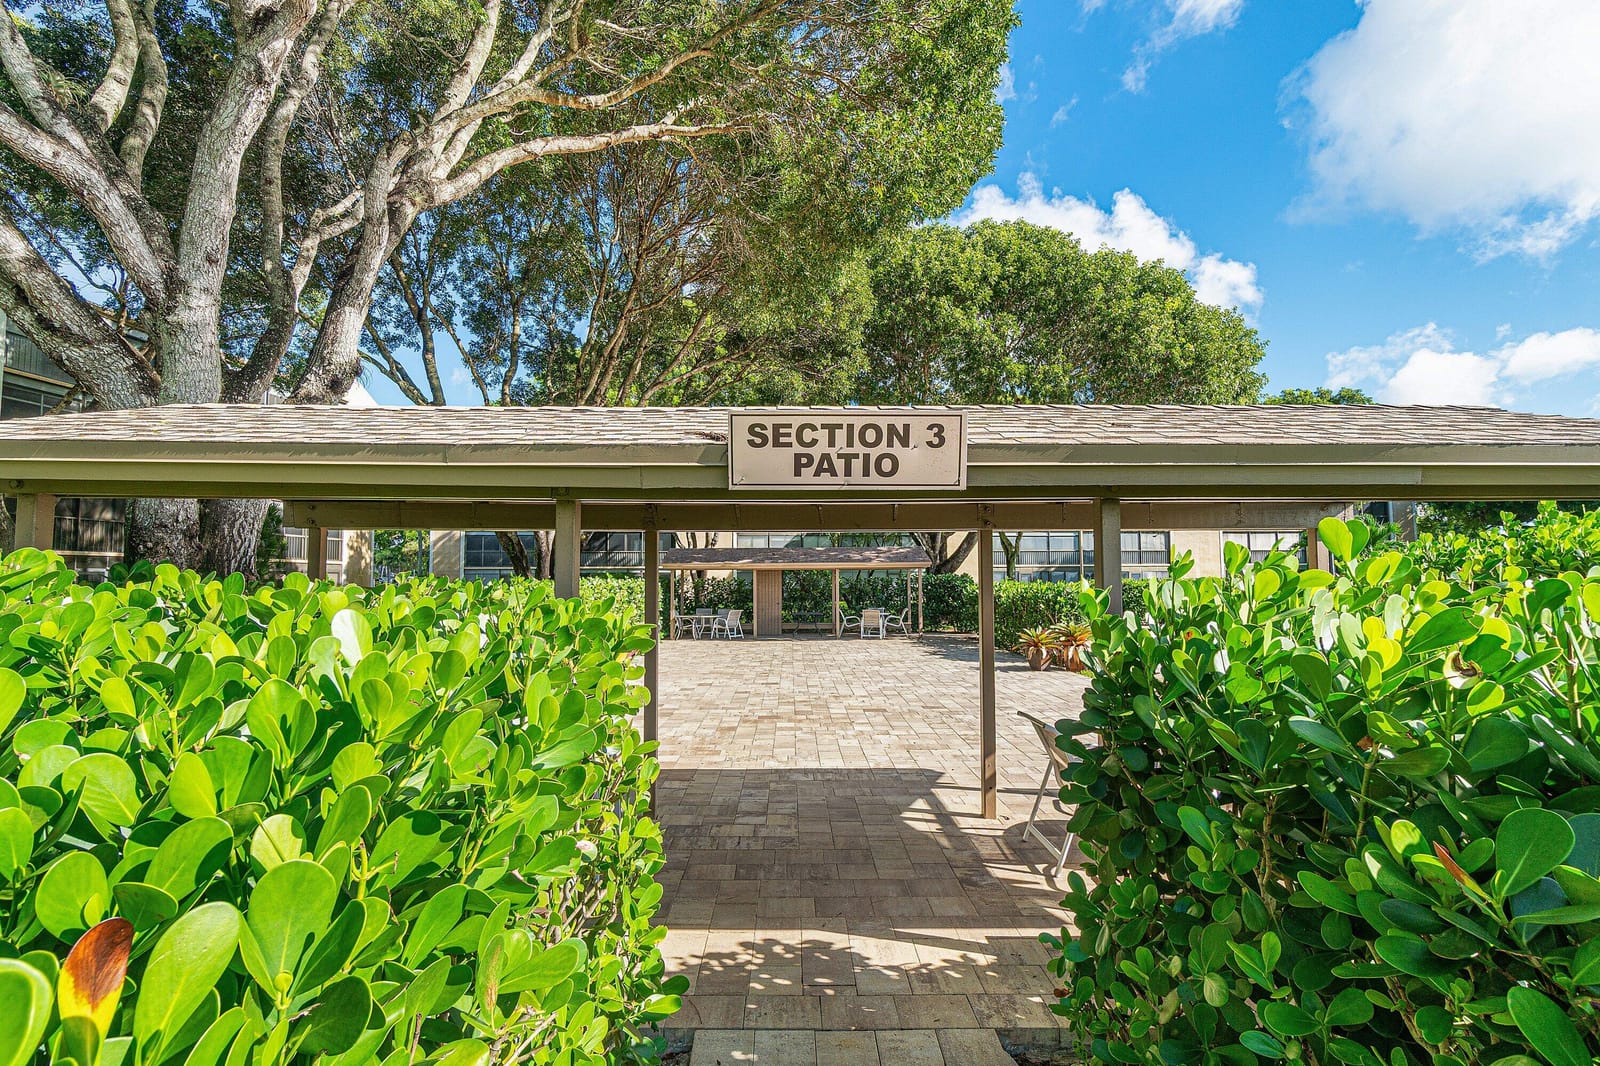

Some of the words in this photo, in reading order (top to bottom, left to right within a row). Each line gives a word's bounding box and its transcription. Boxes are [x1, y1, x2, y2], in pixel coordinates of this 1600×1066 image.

[747, 423, 911, 449] SECTION
[925, 423, 946, 449] 3
[793, 452, 900, 478] PATIO
